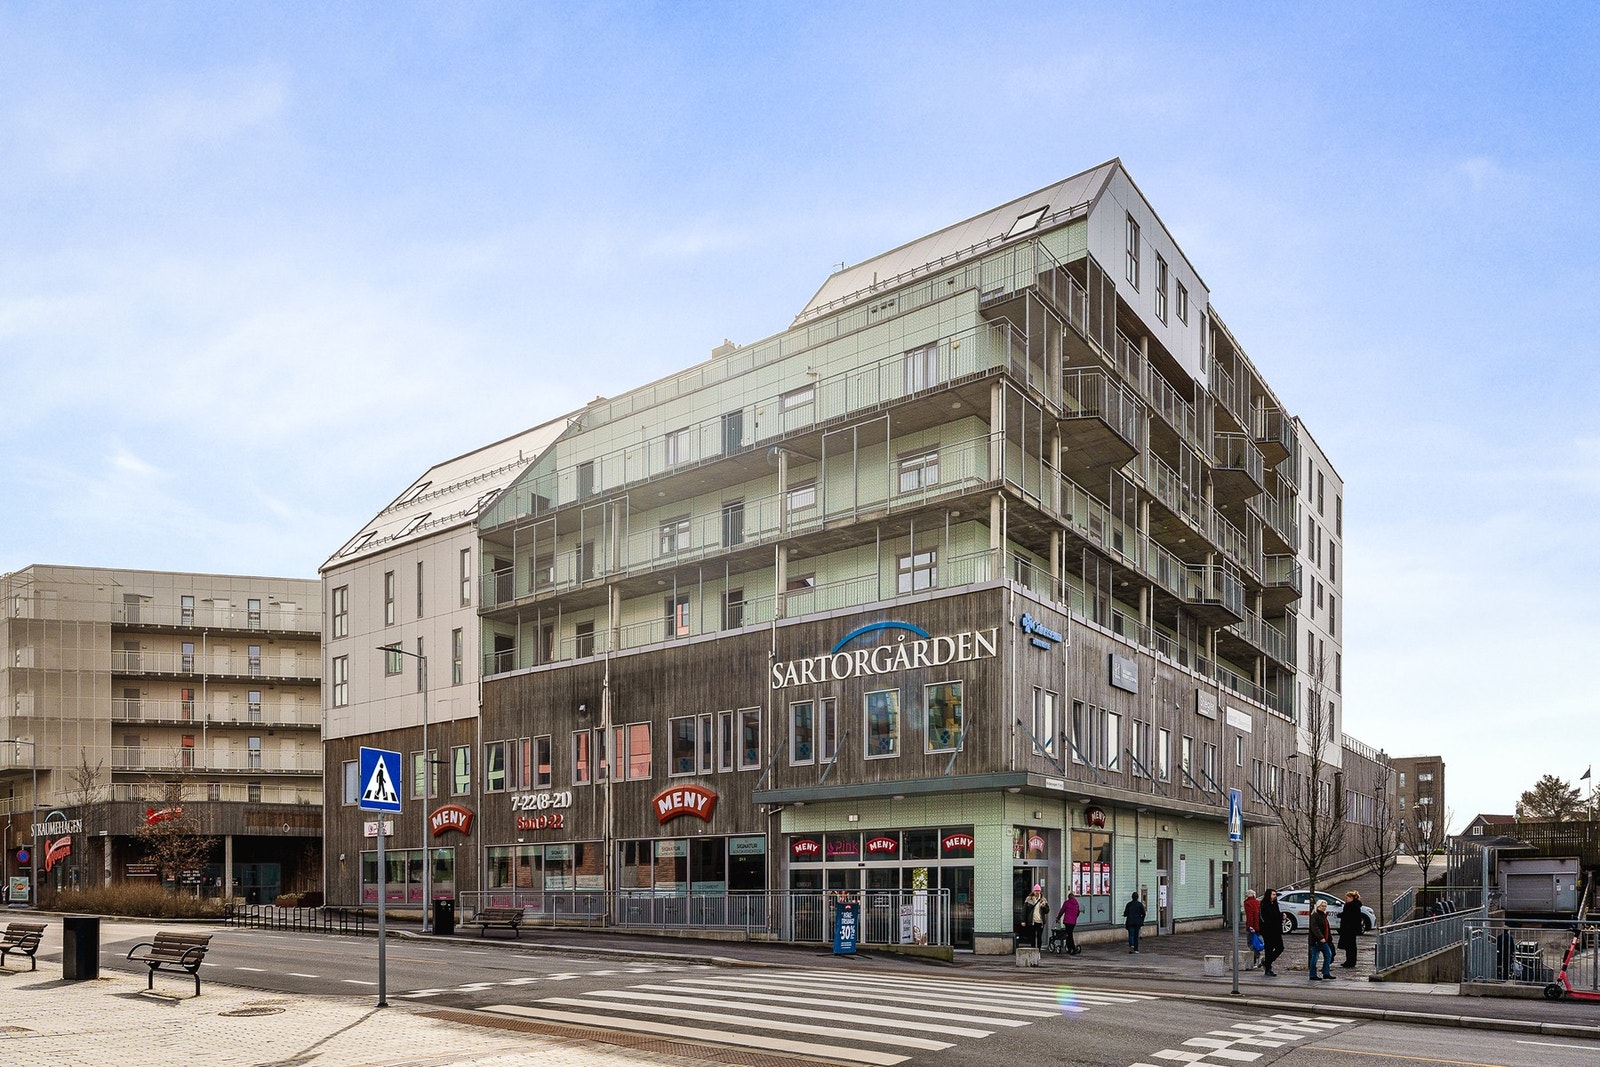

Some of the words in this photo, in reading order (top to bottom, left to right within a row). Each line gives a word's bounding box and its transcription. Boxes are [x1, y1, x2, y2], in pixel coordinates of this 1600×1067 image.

[772, 627, 998, 689] SARTORGÅRDEN
[658, 791, 707, 814] MENY
[432, 810, 466, 829] MENY
[1091, 810, 1105, 822] MENY
[795, 842, 818, 853] MENY
[869, 840, 895, 851] MENY
[946, 837, 974, 849] MENY
[1030, 839, 1043, 849] MENY
